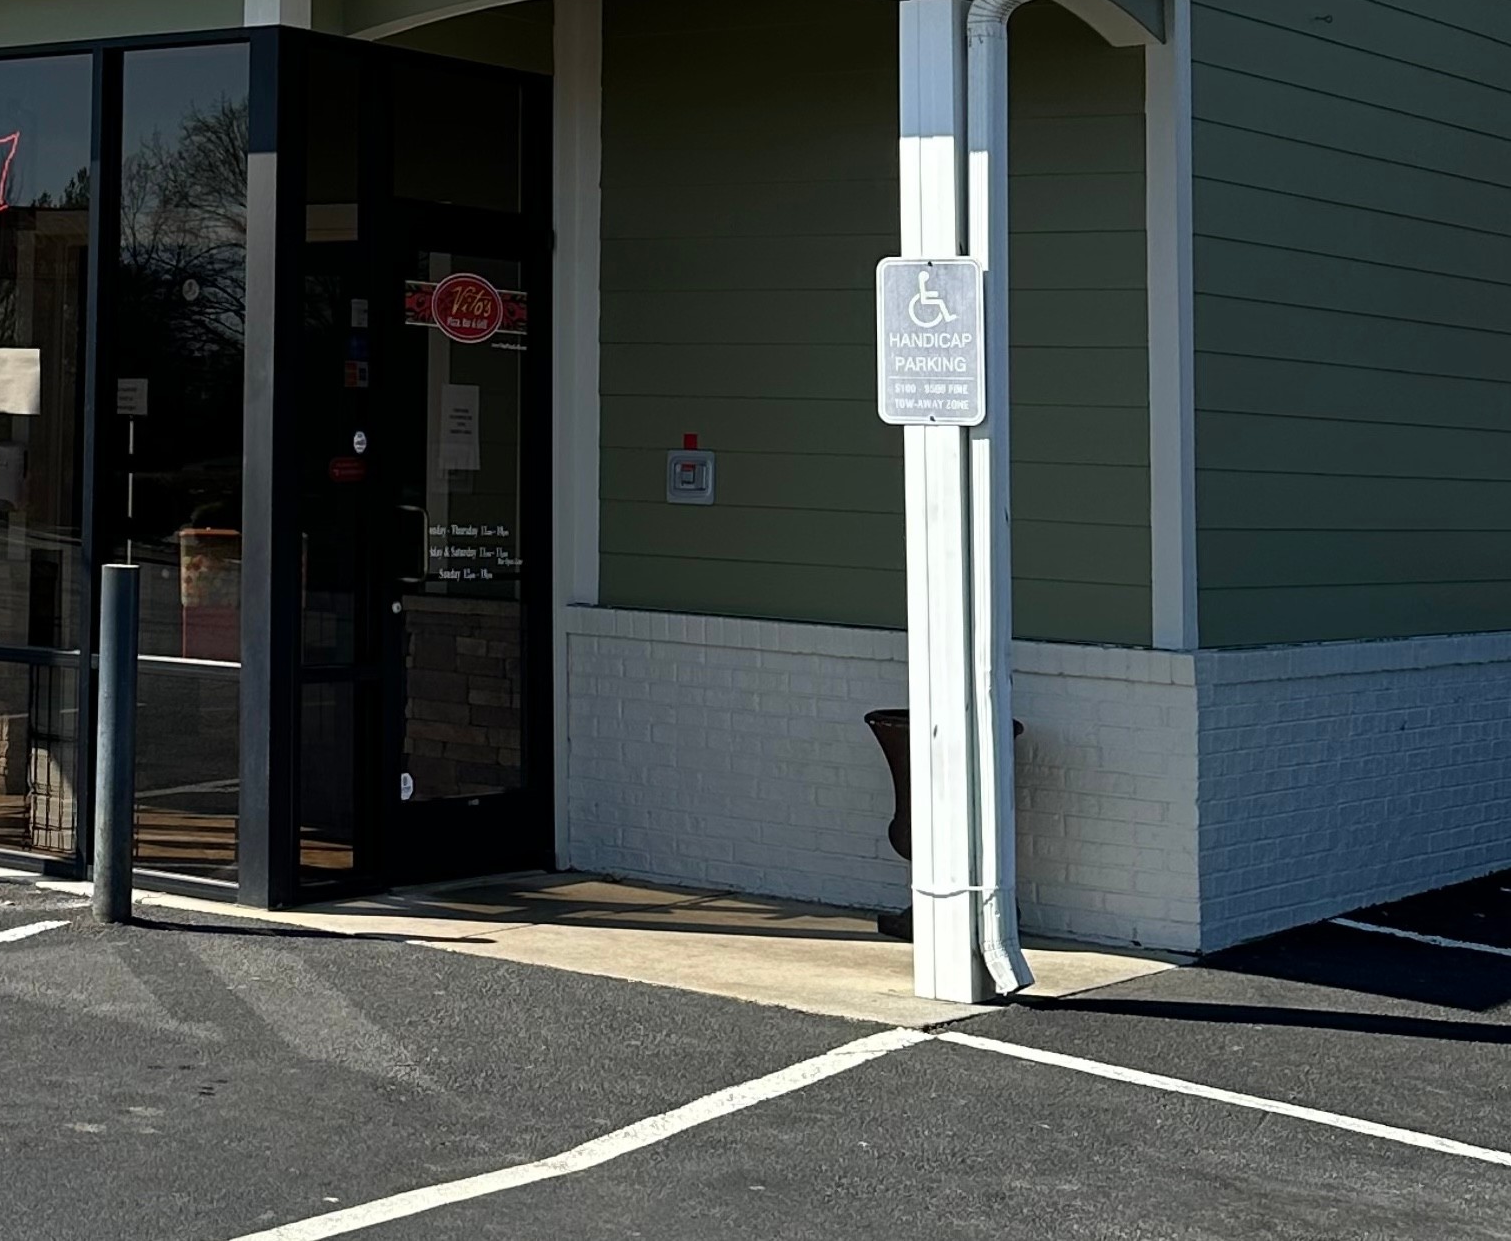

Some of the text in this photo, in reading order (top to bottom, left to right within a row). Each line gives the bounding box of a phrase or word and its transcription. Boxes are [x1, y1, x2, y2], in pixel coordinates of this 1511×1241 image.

[451, 286, 492, 317] Vito's
[889, 332, 972, 348] HANDICAP
[895, 356, 967, 372] PARKING
[895, 383, 916, 393] $100
[948, 384, 969, 394] FINE
[895, 398, 969, 409] TOW-AWAY ZONE
[450, 545, 477, 560] Saturday
[438, 568, 461, 582] Sunday
